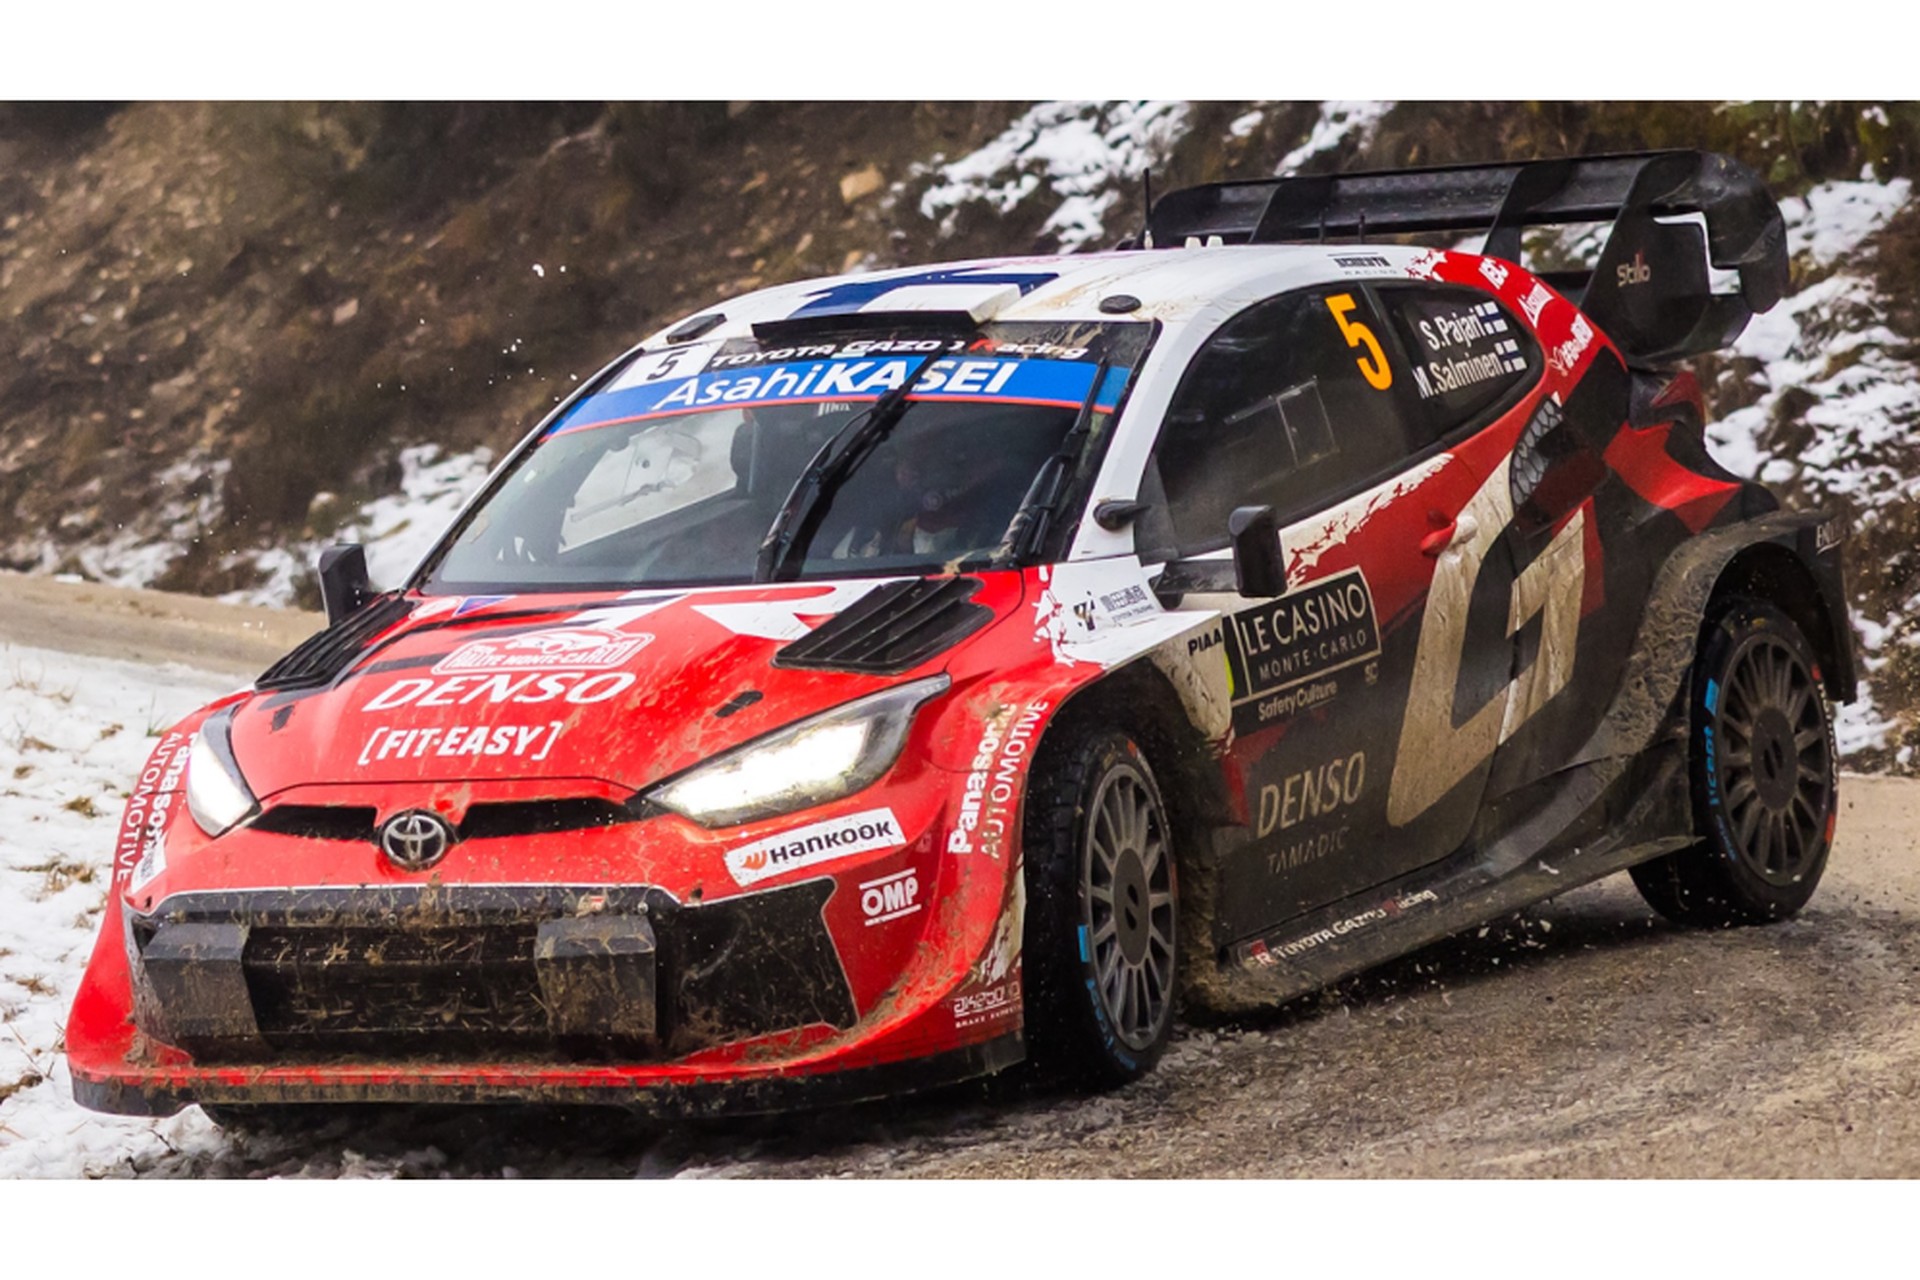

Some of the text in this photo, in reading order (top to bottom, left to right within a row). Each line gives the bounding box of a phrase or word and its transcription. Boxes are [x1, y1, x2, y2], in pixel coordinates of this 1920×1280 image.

[1325, 293, 1393, 391] 5
[1418, 307, 1487, 351] S.Pajari
[645, 349, 689, 381] 5
[711, 343, 837, 368] TOYOTA
[1412, 352, 1505, 399] M.Salminen
[1241, 583, 1367, 656] LE CASINO
[1187, 628, 1223, 657] PIAA
[361, 672, 637, 712] DENSO
[980, 700, 1049, 860] AUTOMOTIVE
[1257, 751, 1365, 840] DENSO
[116, 732, 184, 883] AUTOMOTIVE
[861, 876, 919, 917] OMP
